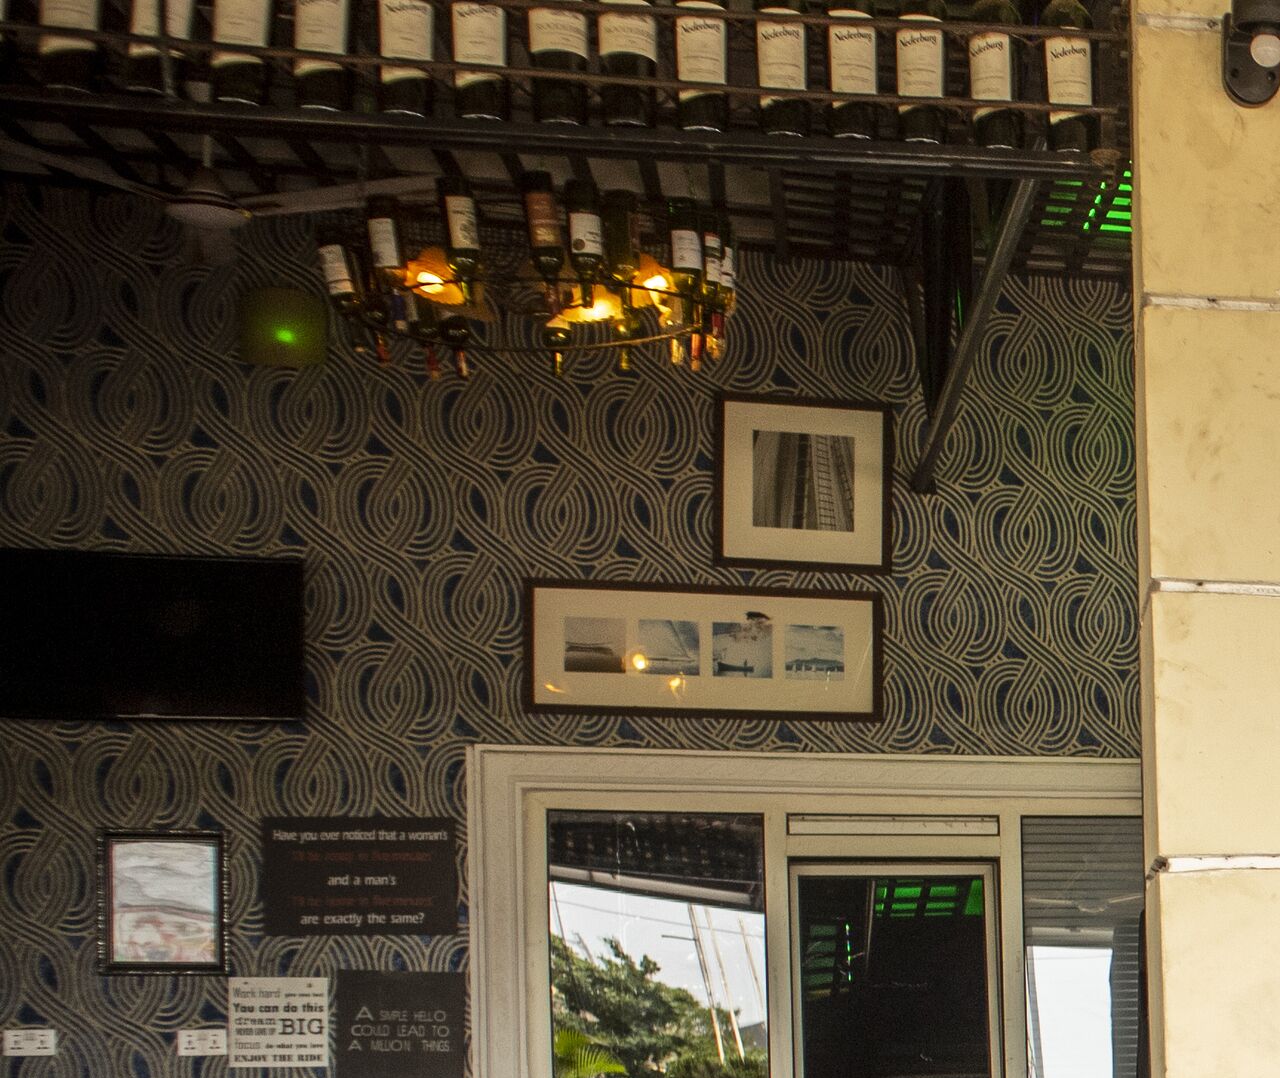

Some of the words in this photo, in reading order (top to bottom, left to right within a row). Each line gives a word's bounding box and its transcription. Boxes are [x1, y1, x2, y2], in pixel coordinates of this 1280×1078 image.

[761, 26, 801, 41] Nederburg
[833, 28, 874, 43] Nederburg
[899, 32, 938, 48] Nederburg
[1050, 45, 1088, 61] Nederburg
[272, 829, 298, 841] Have
[300, 831, 319, 844] you
[320, 830, 341, 841] ever
[342, 829, 376, 841] noticed
[378, 830, 398, 841] that
[399, 832, 406, 841] a
[327, 874, 350, 886] and
[353, 877, 361, 886] a
[364, 874, 396, 886] man's
[300, 914, 319, 925] are
[323, 912, 363, 927] exactly
[367, 912, 386, 924] the
[391, 912, 425, 924] same?
[233, 1002, 255, 1013] You
[258, 1004, 279, 1013] can
[283, 1002, 298, 1013] do
[302, 1002, 324, 1013] this
[355, 1006, 374, 1021] A
[413, 1010, 447, 1022] HELLO
[234, 1017, 276, 1026] dream
[278, 1018, 325, 1036] BIG
[351, 1024, 390, 1037] COULD
[397, 1025, 425, 1037] LEAD
[432, 1025, 450, 1037] TO
[347, 1040, 362, 1051] A
[234, 1054, 267, 1062] ENJOY
[272, 1054, 293, 1062] THE
[297, 1054, 323, 1062] RIDE
